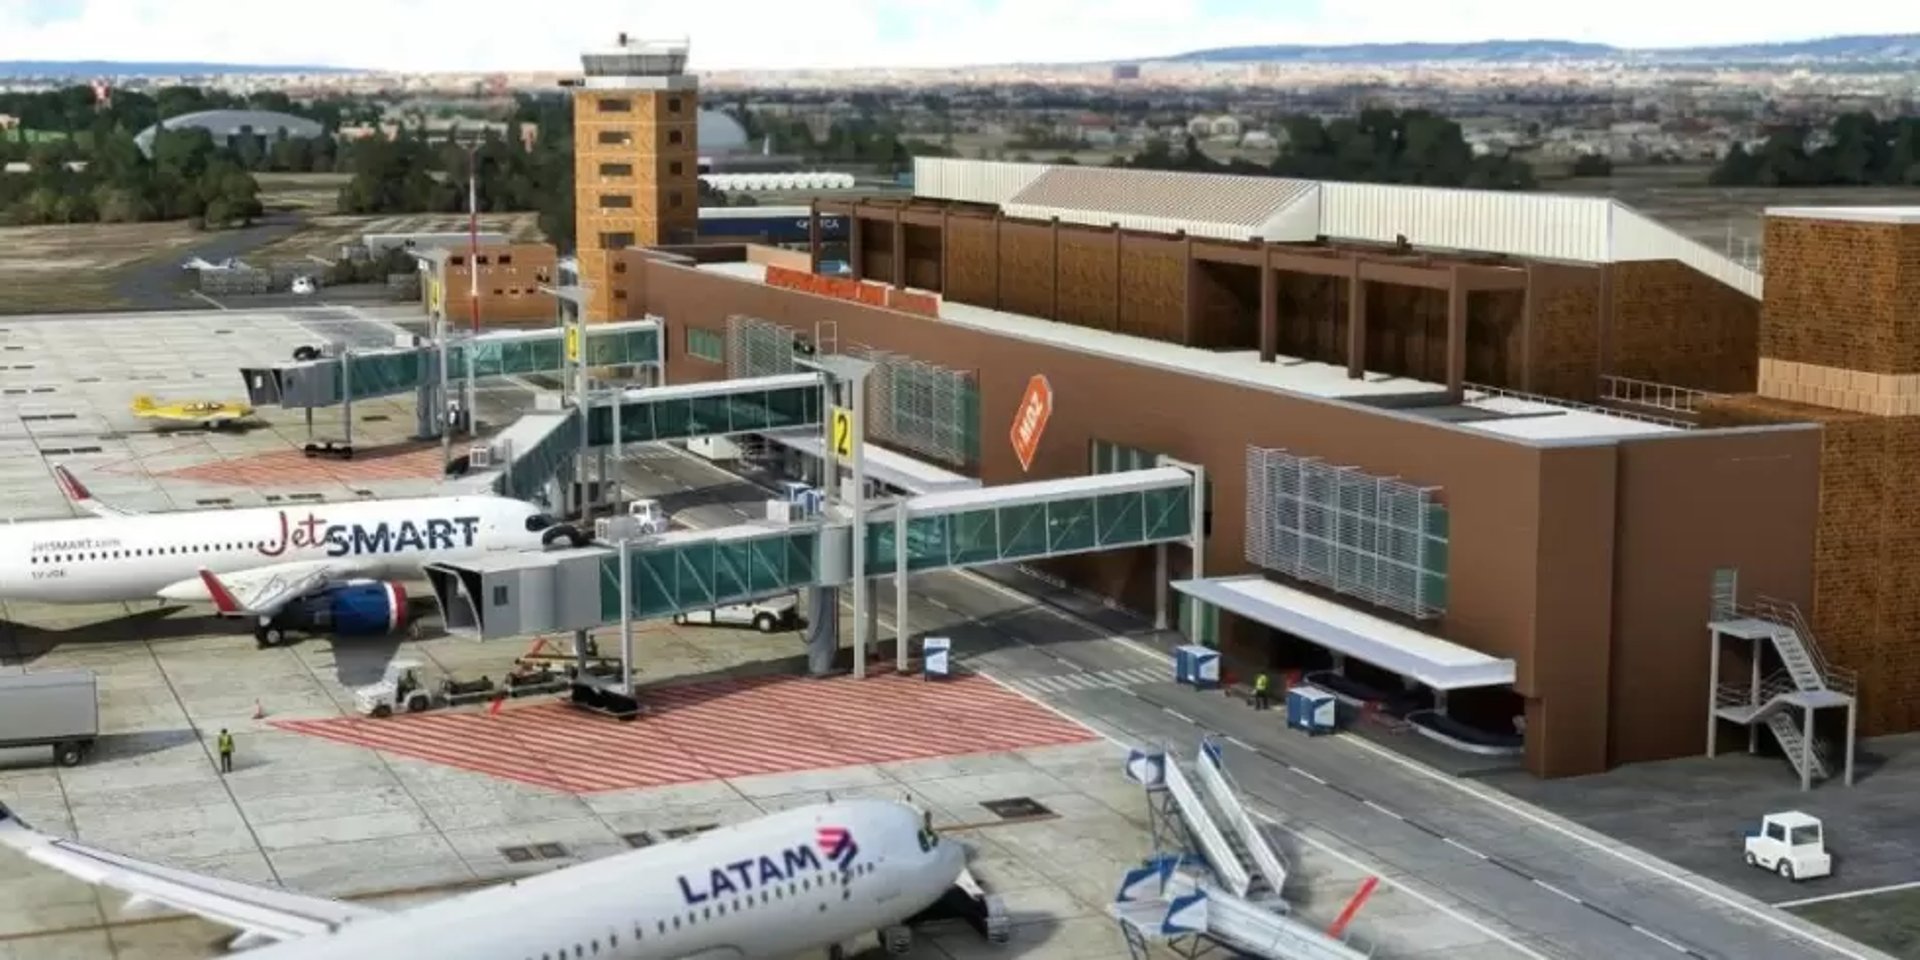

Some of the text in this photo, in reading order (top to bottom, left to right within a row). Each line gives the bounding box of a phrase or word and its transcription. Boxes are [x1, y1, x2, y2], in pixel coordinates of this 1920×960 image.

[838, 414, 848, 455] 2
[1019, 391, 1043, 445] MDZ
[677, 845, 821, 904] LATAM
